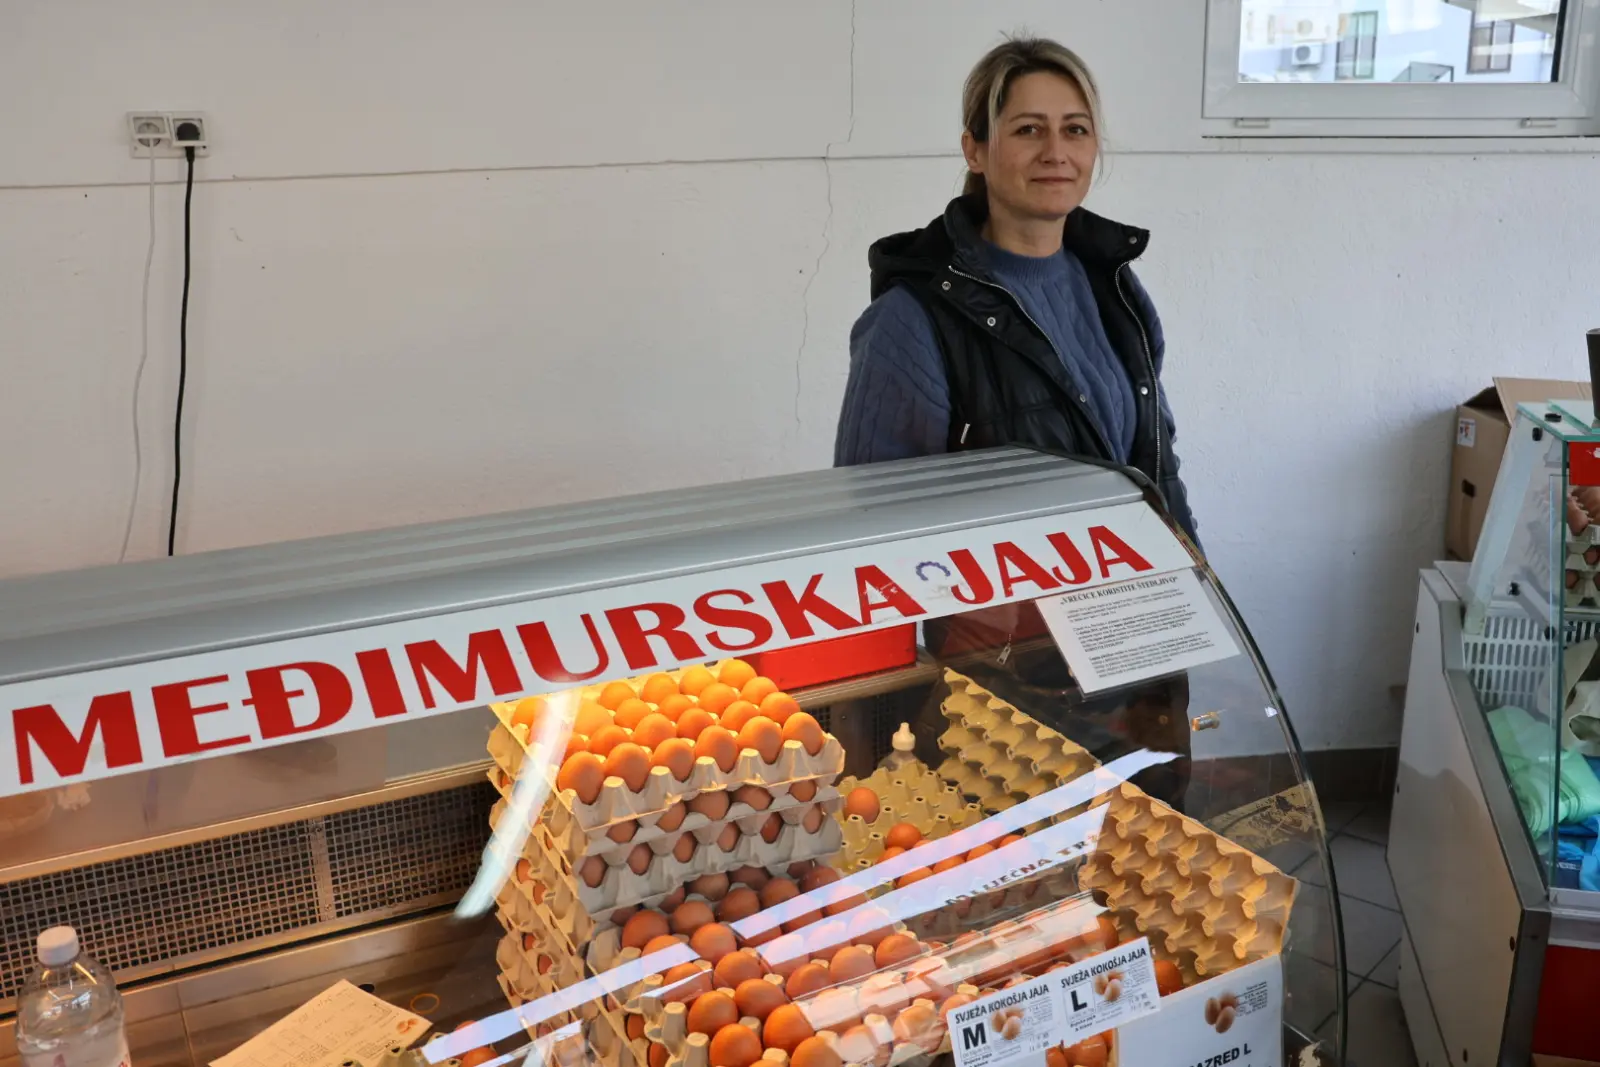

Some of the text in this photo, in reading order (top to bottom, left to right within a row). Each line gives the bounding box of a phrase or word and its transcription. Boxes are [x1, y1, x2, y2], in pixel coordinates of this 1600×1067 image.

[1096, 584, 1136, 599] KORISTITE
[11, 525, 1155, 786] MEĐIMURSKA JAJA
[1060, 968, 1092, 988] SVJEŽA
[1091, 955, 1128, 977] KOKOŠJA
[1127, 947, 1147, 962] JAJA
[955, 1005, 987, 1024] SVJEŽA
[988, 990, 1028, 1013] KOKOŠJA
[1028, 983, 1050, 999] JAJA
[1070, 990, 1088, 1012] L
[962, 1021, 987, 1050] M
[1243, 1042, 1252, 1056] L
